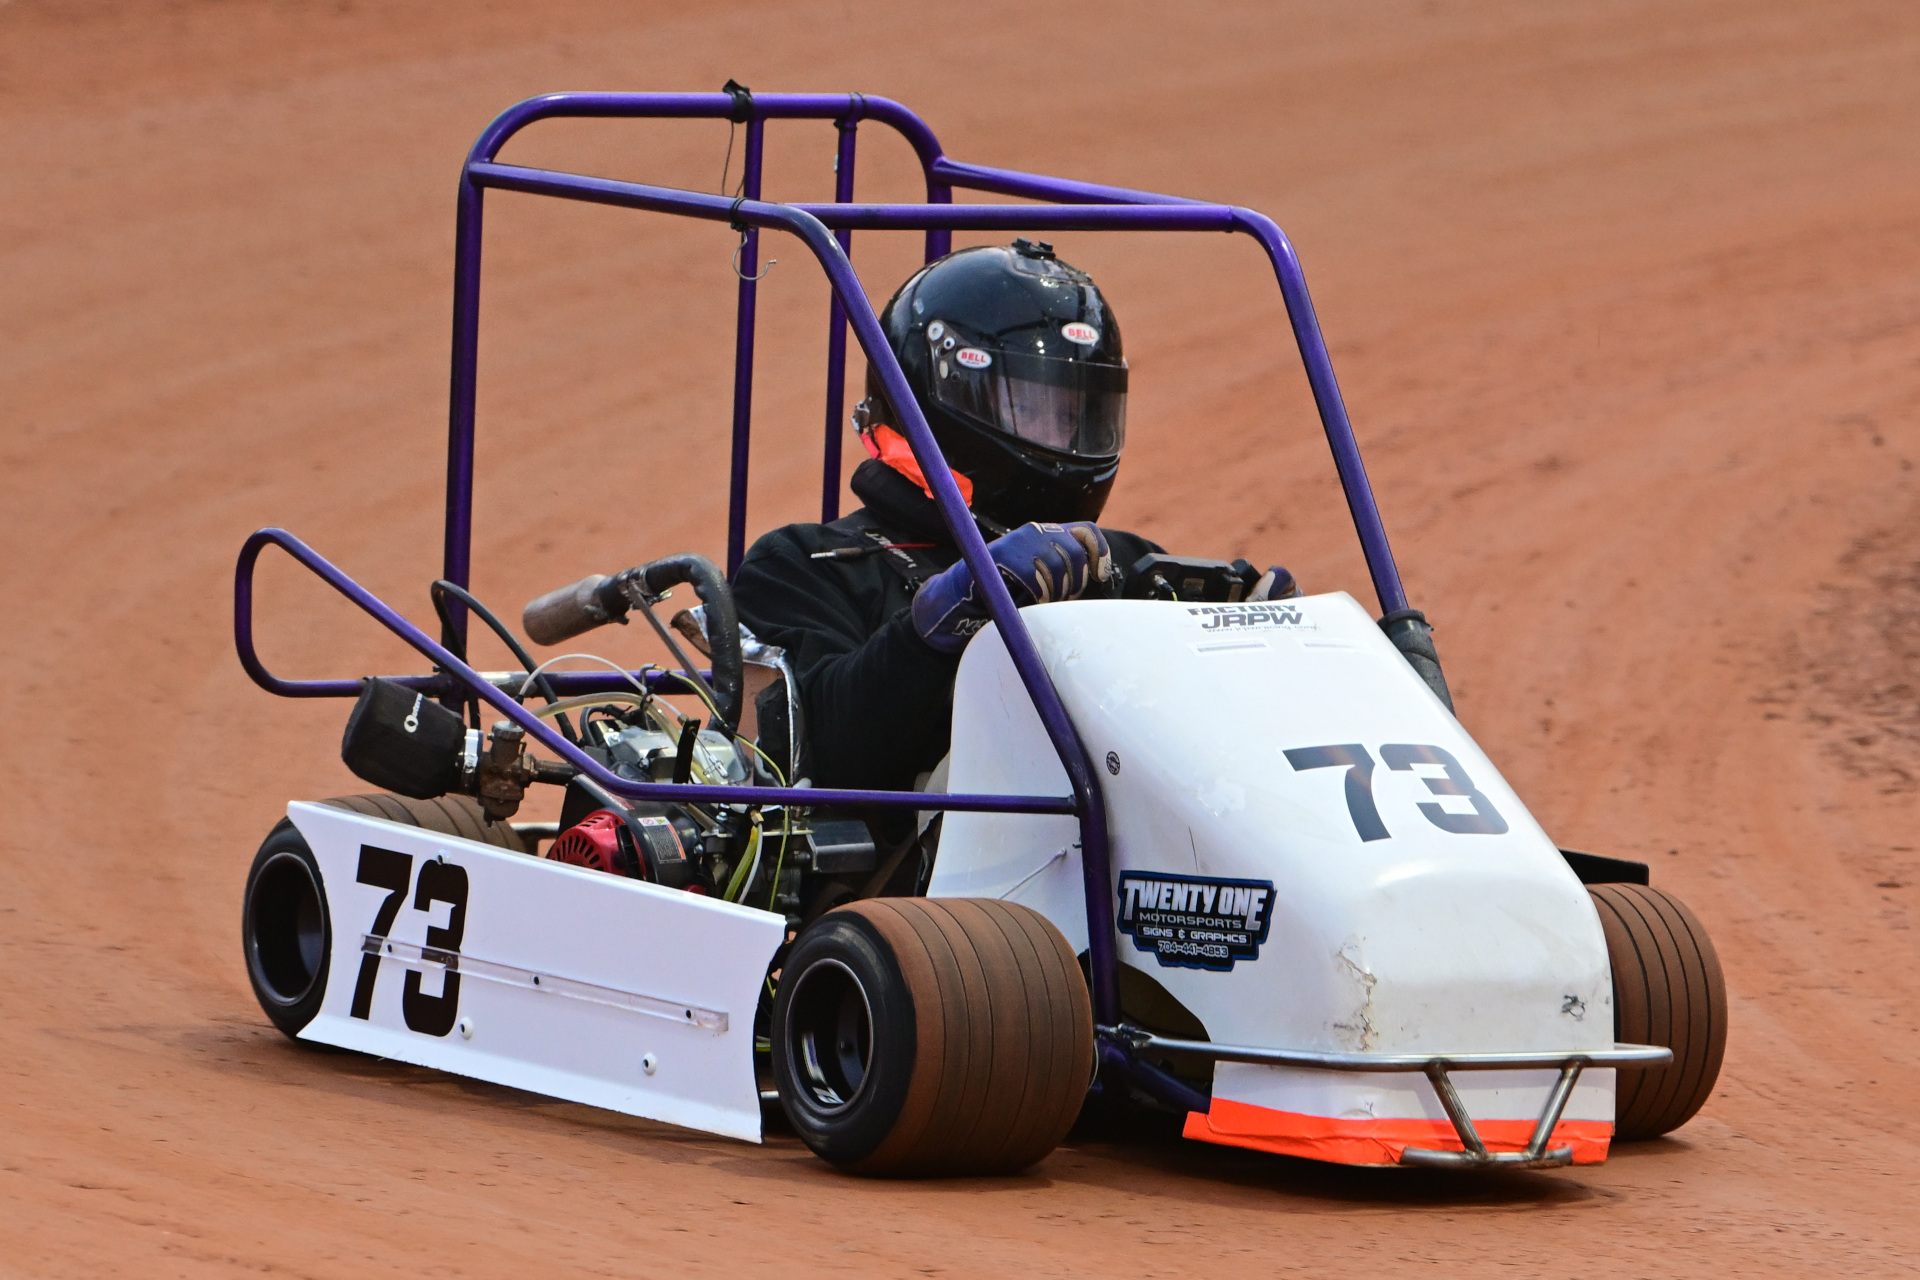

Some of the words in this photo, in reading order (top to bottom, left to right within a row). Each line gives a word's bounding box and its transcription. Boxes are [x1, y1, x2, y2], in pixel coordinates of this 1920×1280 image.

[1068, 328, 1095, 340] BELL
[961, 351, 986, 363] BELL
[1187, 605, 1297, 615] FACTORY
[1201, 612, 1303, 629] JRPW
[1282, 743, 1509, 842] 73
[1124, 879, 1217, 920] TWENTY
[1217, 887, 1268, 931] ONE
[1139, 912, 1242, 929] MOTORSPORTS
[350, 844, 469, 1037] 73
[1142, 927, 1173, 938] SIGNS
[1190, 932, 1247, 943] GRAPHICS
[1158, 941, 1228, 958] 704-441-4853
